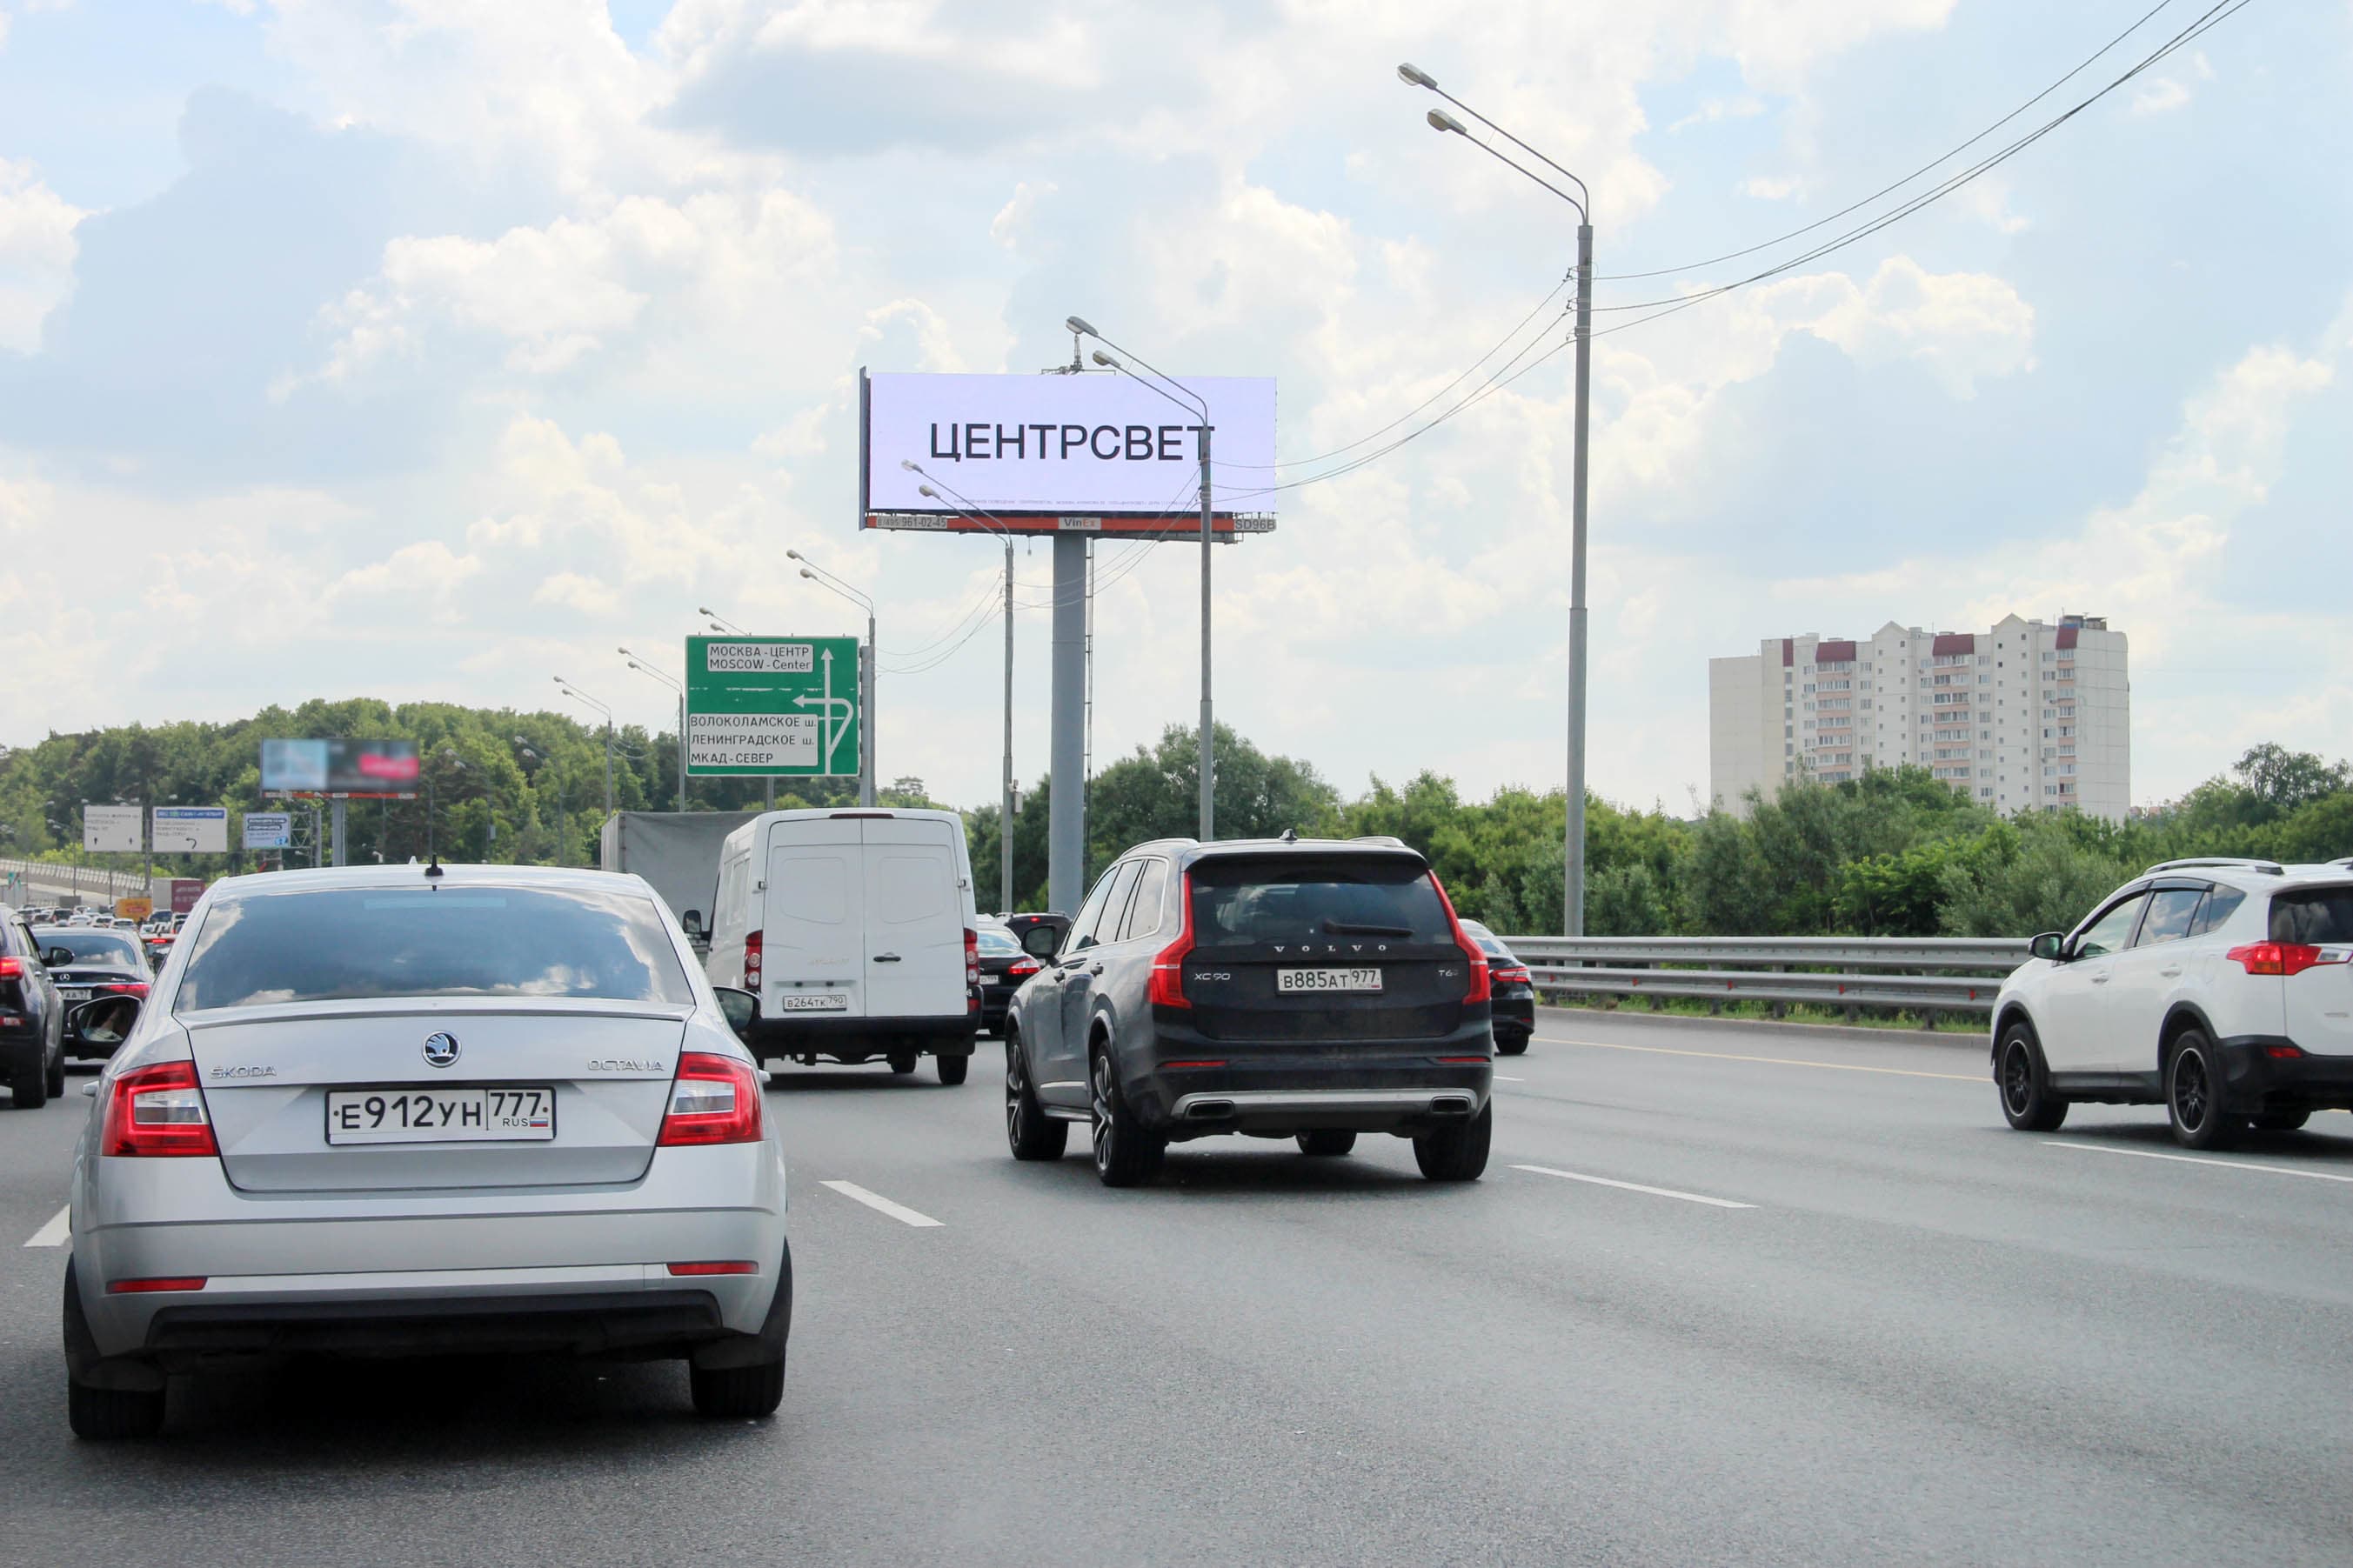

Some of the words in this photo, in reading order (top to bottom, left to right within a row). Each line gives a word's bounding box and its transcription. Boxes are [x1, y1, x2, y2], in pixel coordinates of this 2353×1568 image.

[931, 423, 1215, 462] ЦЕНТРСВЕТ
[1235, 518, 1276, 530] SD96B
[710, 646, 761, 657] МОСКВА
[770, 646, 810, 658] ЦЕНТР
[710, 659, 765, 669] MOSCOW
[772, 659, 812, 670] Center
[691, 716, 800, 727] ВОЛОКОЛАМСКОЕ
[804, 718, 817, 728] ш.
[692, 734, 796, 746] ЛЕНИНГРАДСКОЕ
[802, 737, 815, 745] ш.
[691, 753, 728, 764] МКАД
[736, 752, 773, 764] СЕВЕР
[1352, 970, 1376, 983] 977
[587, 1058, 665, 1071] OCTAVIA
[490, 1091, 542, 1117] 777
[502, 1118, 529, 1127] RUS
